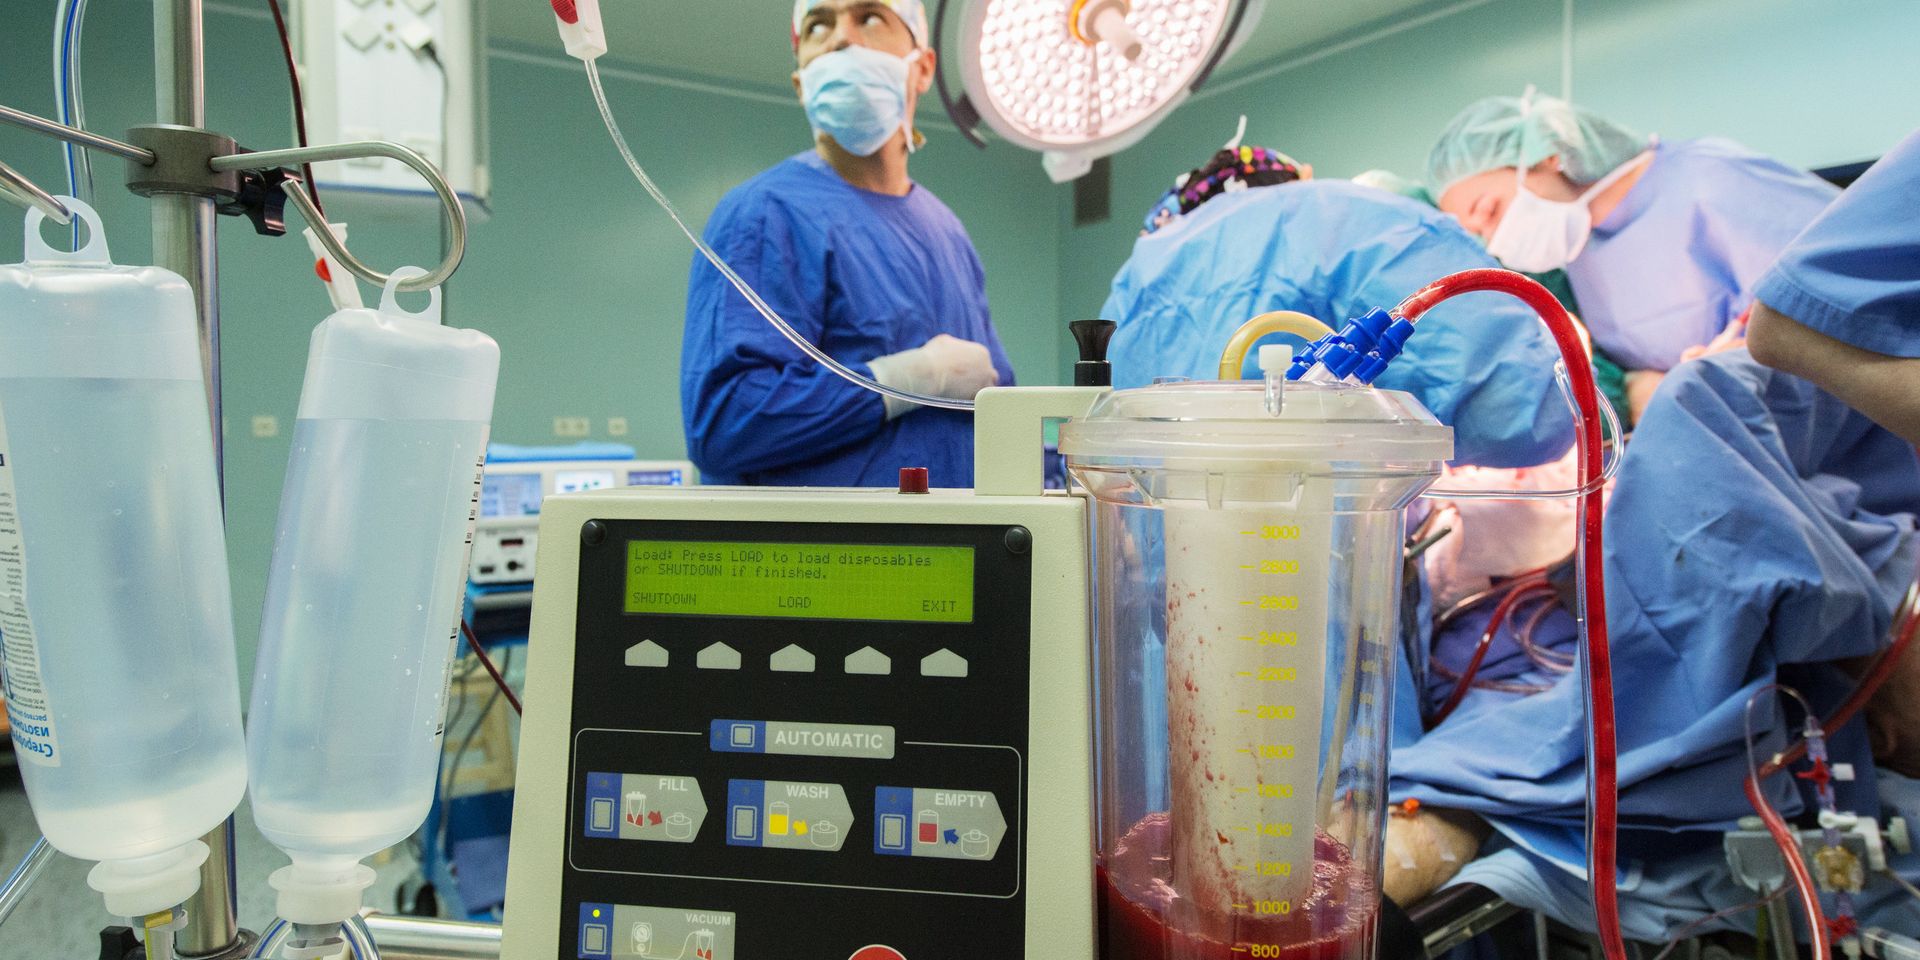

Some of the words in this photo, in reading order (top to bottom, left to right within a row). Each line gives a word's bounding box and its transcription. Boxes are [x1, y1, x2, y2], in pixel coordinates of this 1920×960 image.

[1260, 525, 1300, 540] 3000
[634, 549, 672, 561] Load:
[682, 550, 723, 562] Press
[731, 550, 764, 563] LOAD
[772, 551, 789, 563] to
[798, 552, 830, 564] load
[838, 552, 932, 567] disposables
[634, 565, 649, 575] or
[658, 563, 723, 577] SHUTDOWN
[732, 565, 746, 577] if
[755, 565, 827, 579] finished.
[1259, 560, 1300, 574] 2800
[632, 592, 697, 606] SHUTDOWN
[778, 596, 812, 609] LOAD
[922, 600, 957, 613] EXIT
[1259, 595, 1299, 610] 2600
[1257, 631, 1298, 646] 2400
[1256, 666, 1297, 681] 2200
[1256, 705, 1296, 720] 2000
[774, 730, 884, 749] AUTOMATIC
[1258, 745, 1295, 760] 1800
[658, 777, 689, 792] FILL
[786, 784, 830, 799] WASH
[1257, 784, 1294, 798] 1600
[935, 792, 987, 808] EMPTY
[1256, 823, 1293, 837] 1400
[1255, 862, 1292, 878] 1200
[1253, 900, 1291, 915] 1000
[685, 913, 731, 926] VACUUM
[1251, 943, 1280, 958] 800
